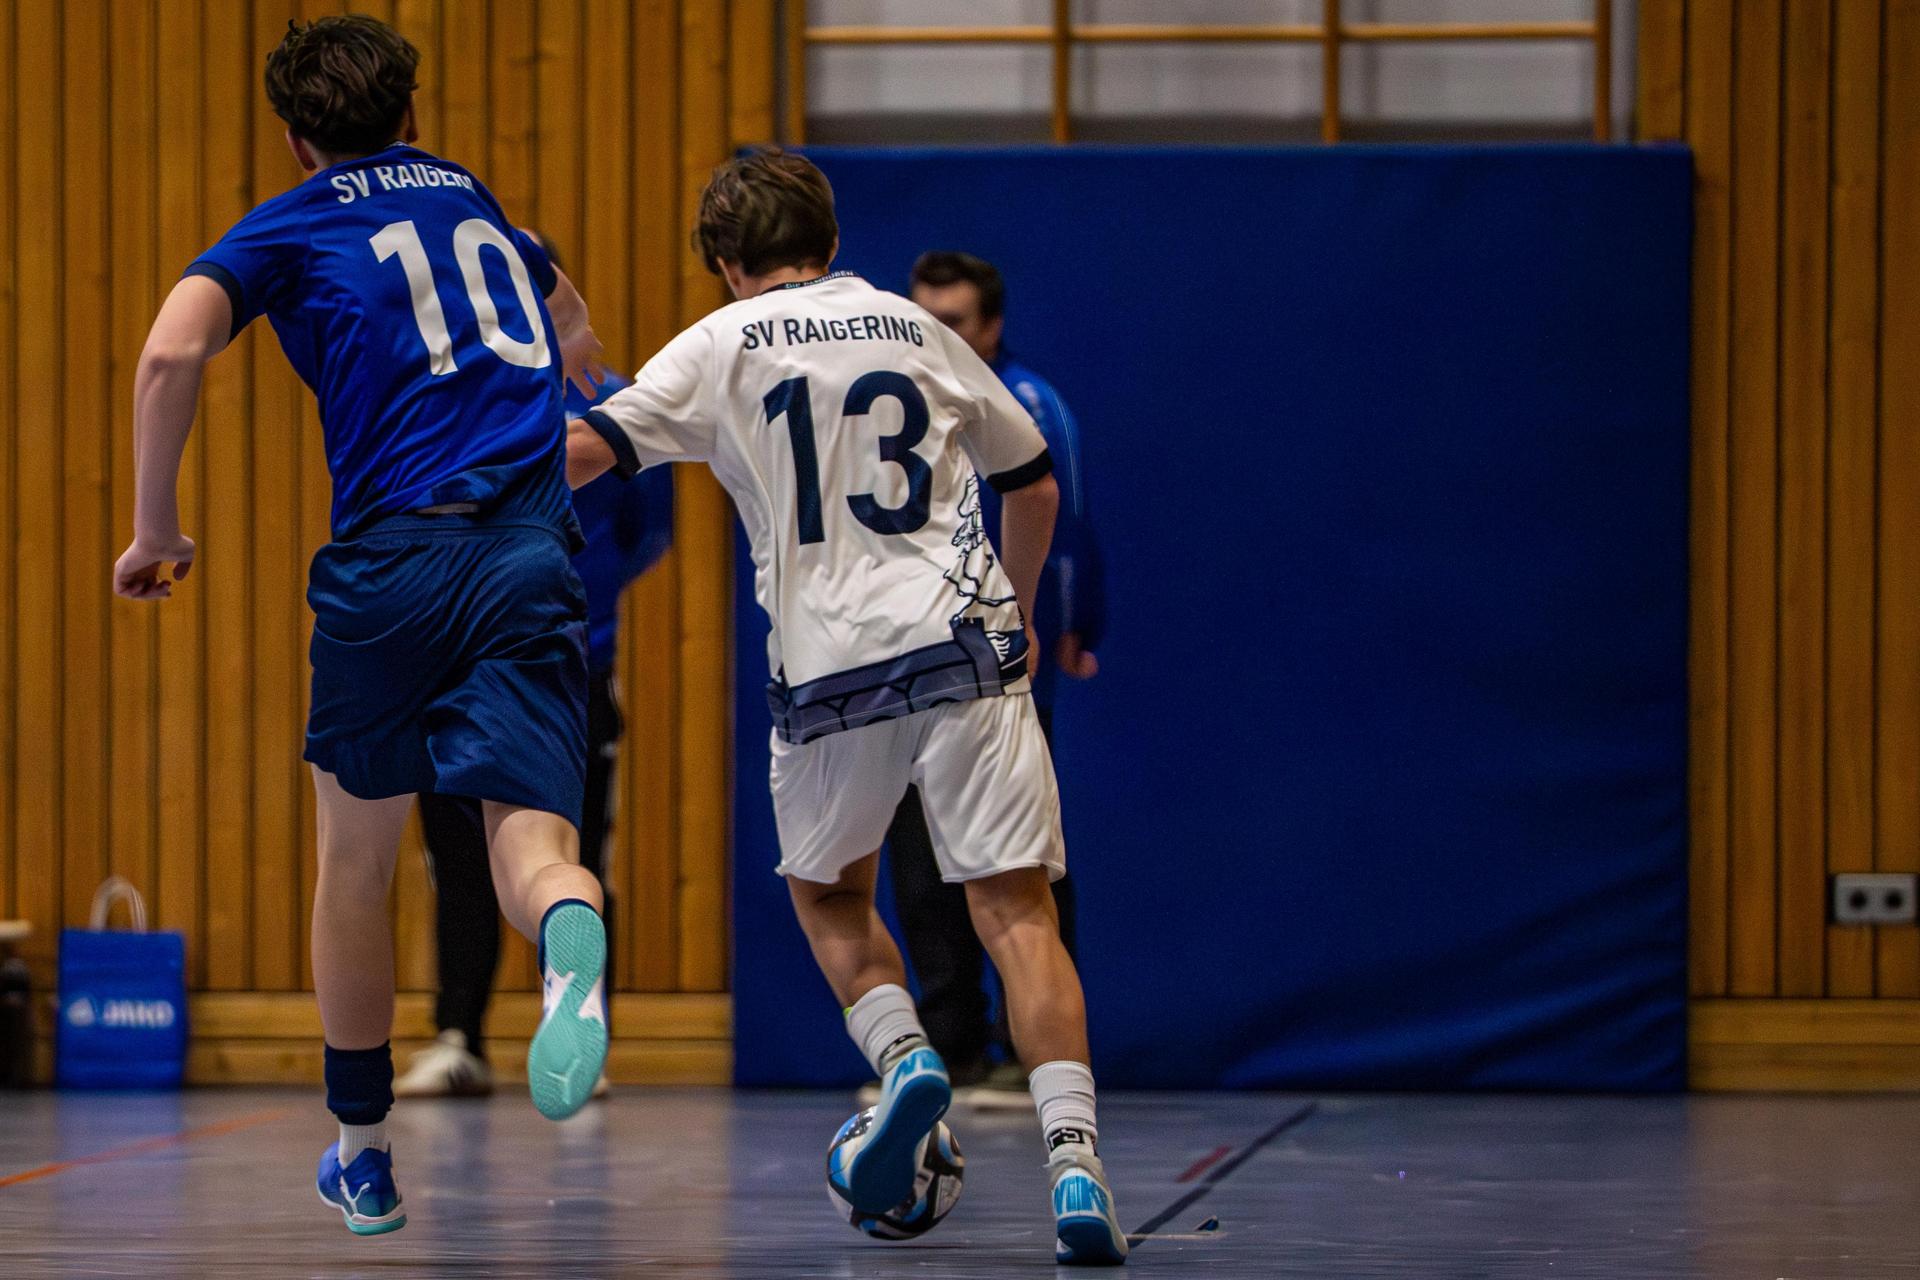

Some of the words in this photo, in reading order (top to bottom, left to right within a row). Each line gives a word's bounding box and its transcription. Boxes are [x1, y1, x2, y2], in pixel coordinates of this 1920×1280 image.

[330, 169, 371, 204] SV
[369, 218, 551, 376] 10
[742, 320, 774, 350] SV
[784, 315, 924, 348] RAIGERING
[763, 370, 933, 546] 13
